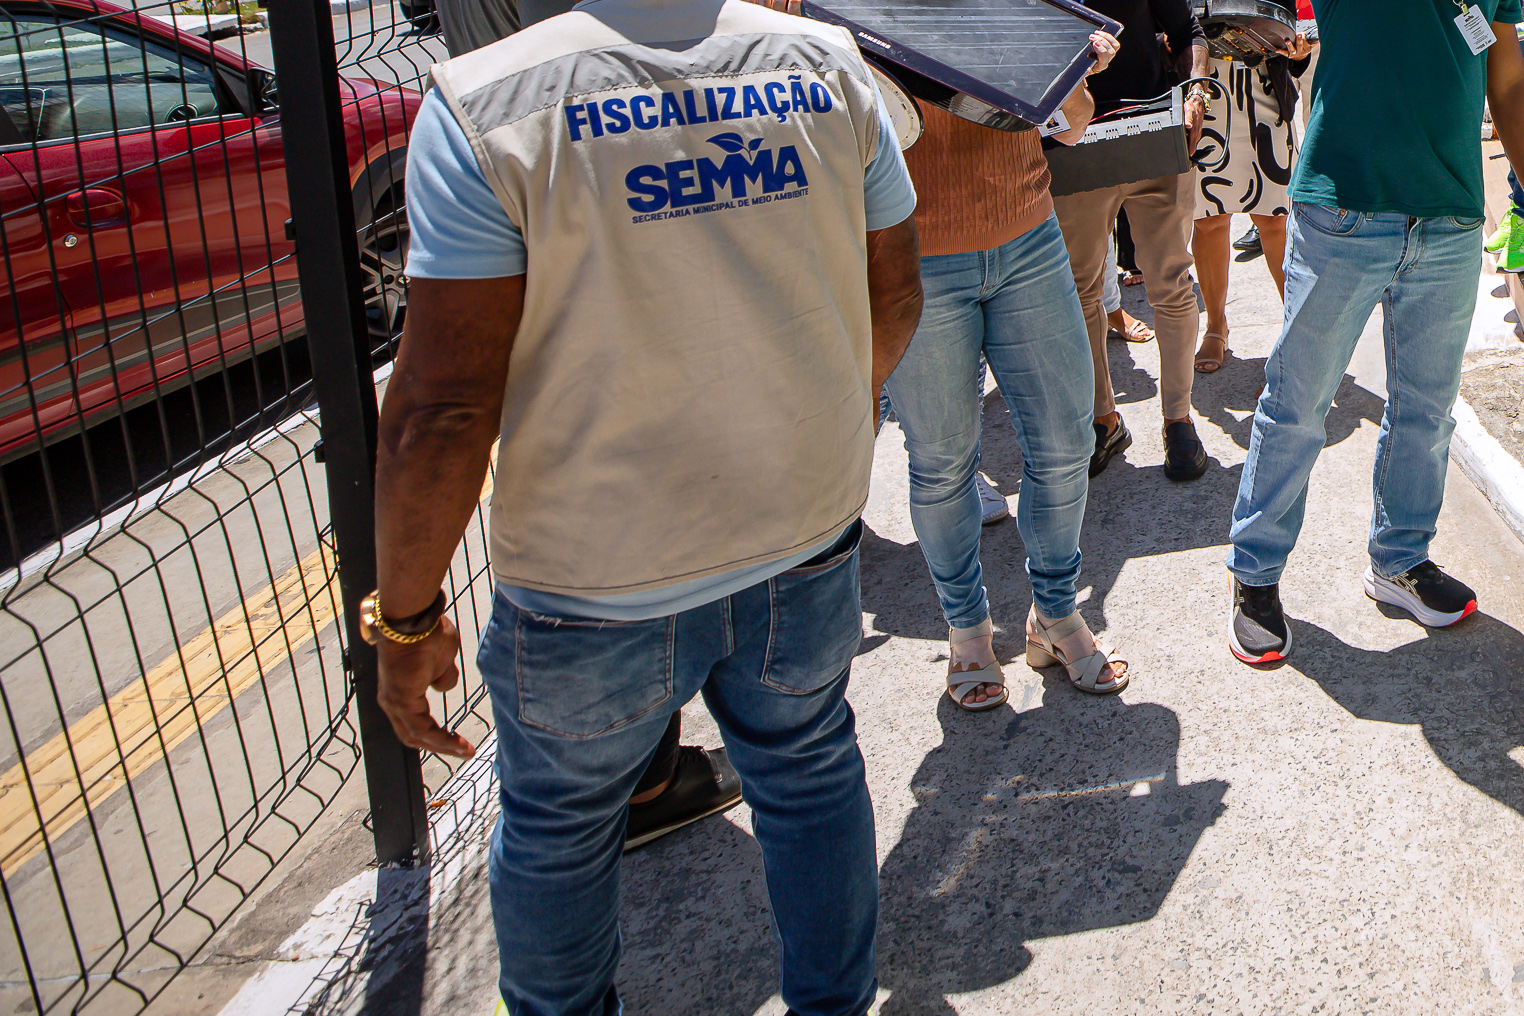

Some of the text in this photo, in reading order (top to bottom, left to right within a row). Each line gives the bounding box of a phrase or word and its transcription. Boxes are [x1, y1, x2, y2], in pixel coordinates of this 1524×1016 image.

[858, 32, 891, 49] SAMSUNG
[564, 74, 833, 142] FISCALIZAÇÃO
[625, 145, 809, 213] SEMMA
[632, 188, 809, 224] SECRETARIA MUNICIPAL DE MEIO AMBIENTE
